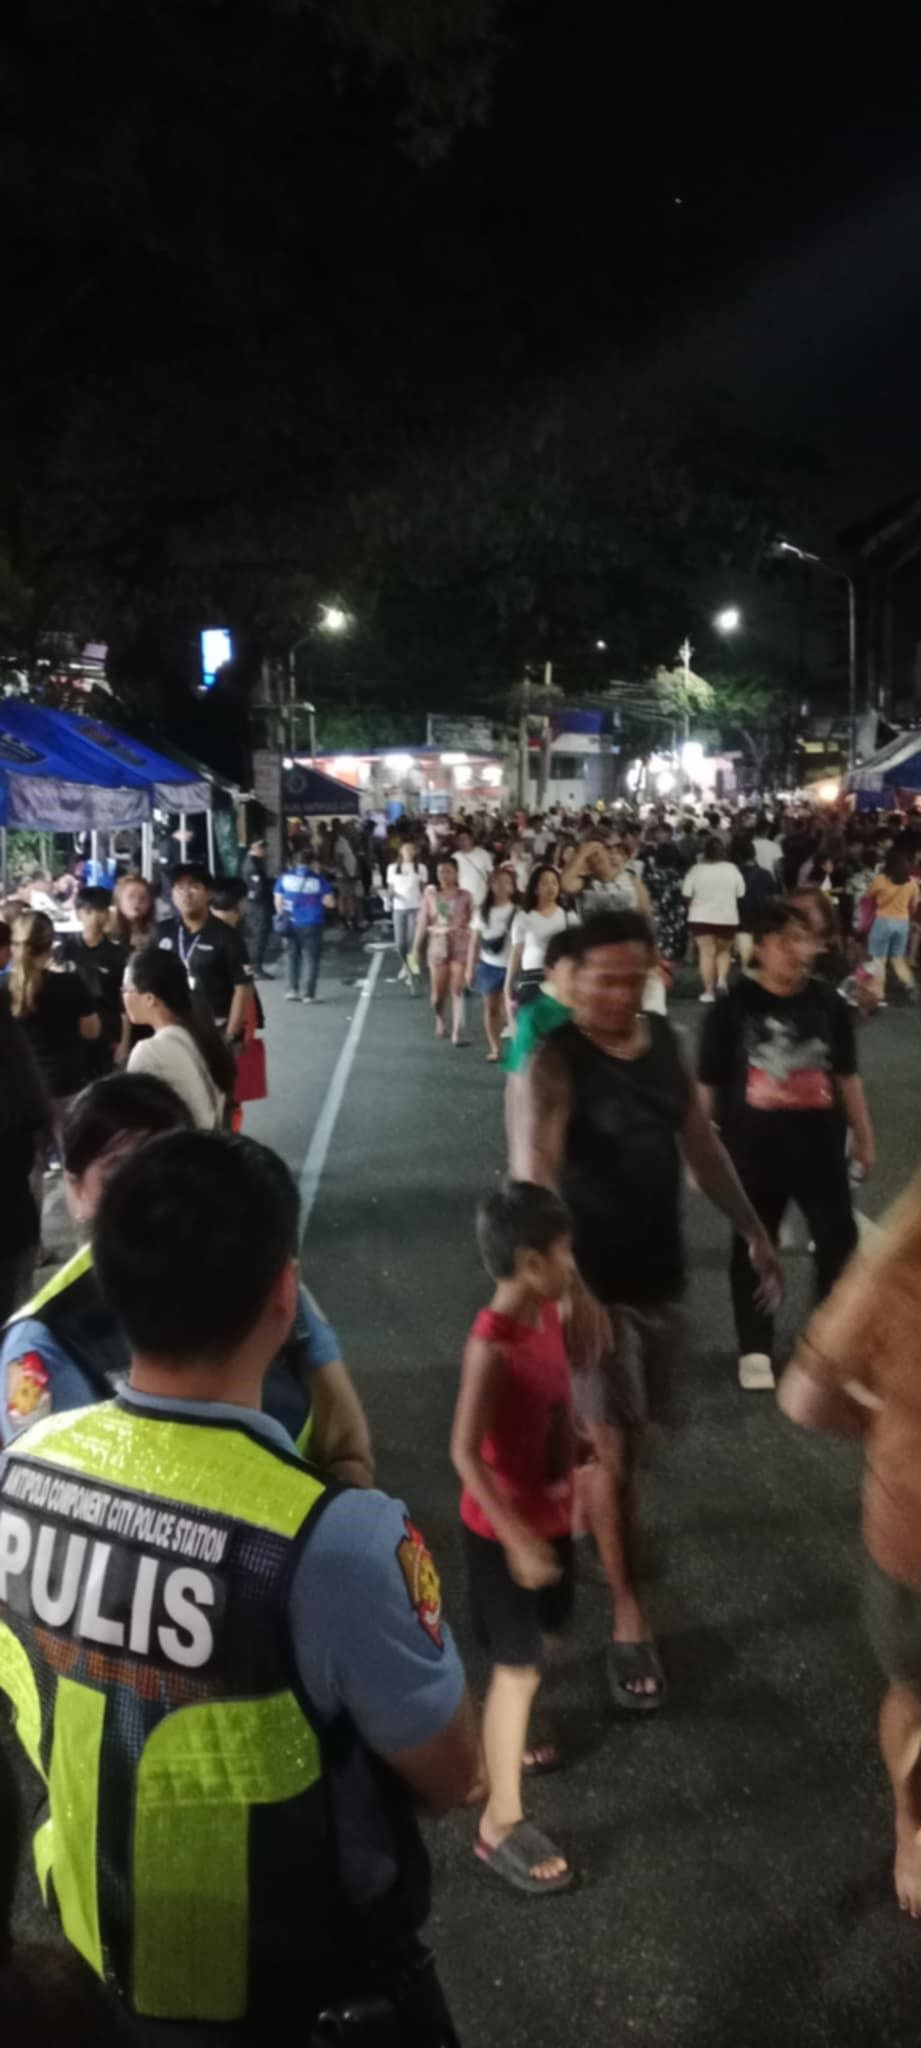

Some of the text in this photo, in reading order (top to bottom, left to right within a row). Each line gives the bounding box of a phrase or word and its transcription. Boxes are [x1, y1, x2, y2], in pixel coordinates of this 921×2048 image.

[2, 1465, 228, 1563] ANTIPOLO COMPONENT CITY POLICE STATION
[0, 1511, 214, 1668] PULIS
